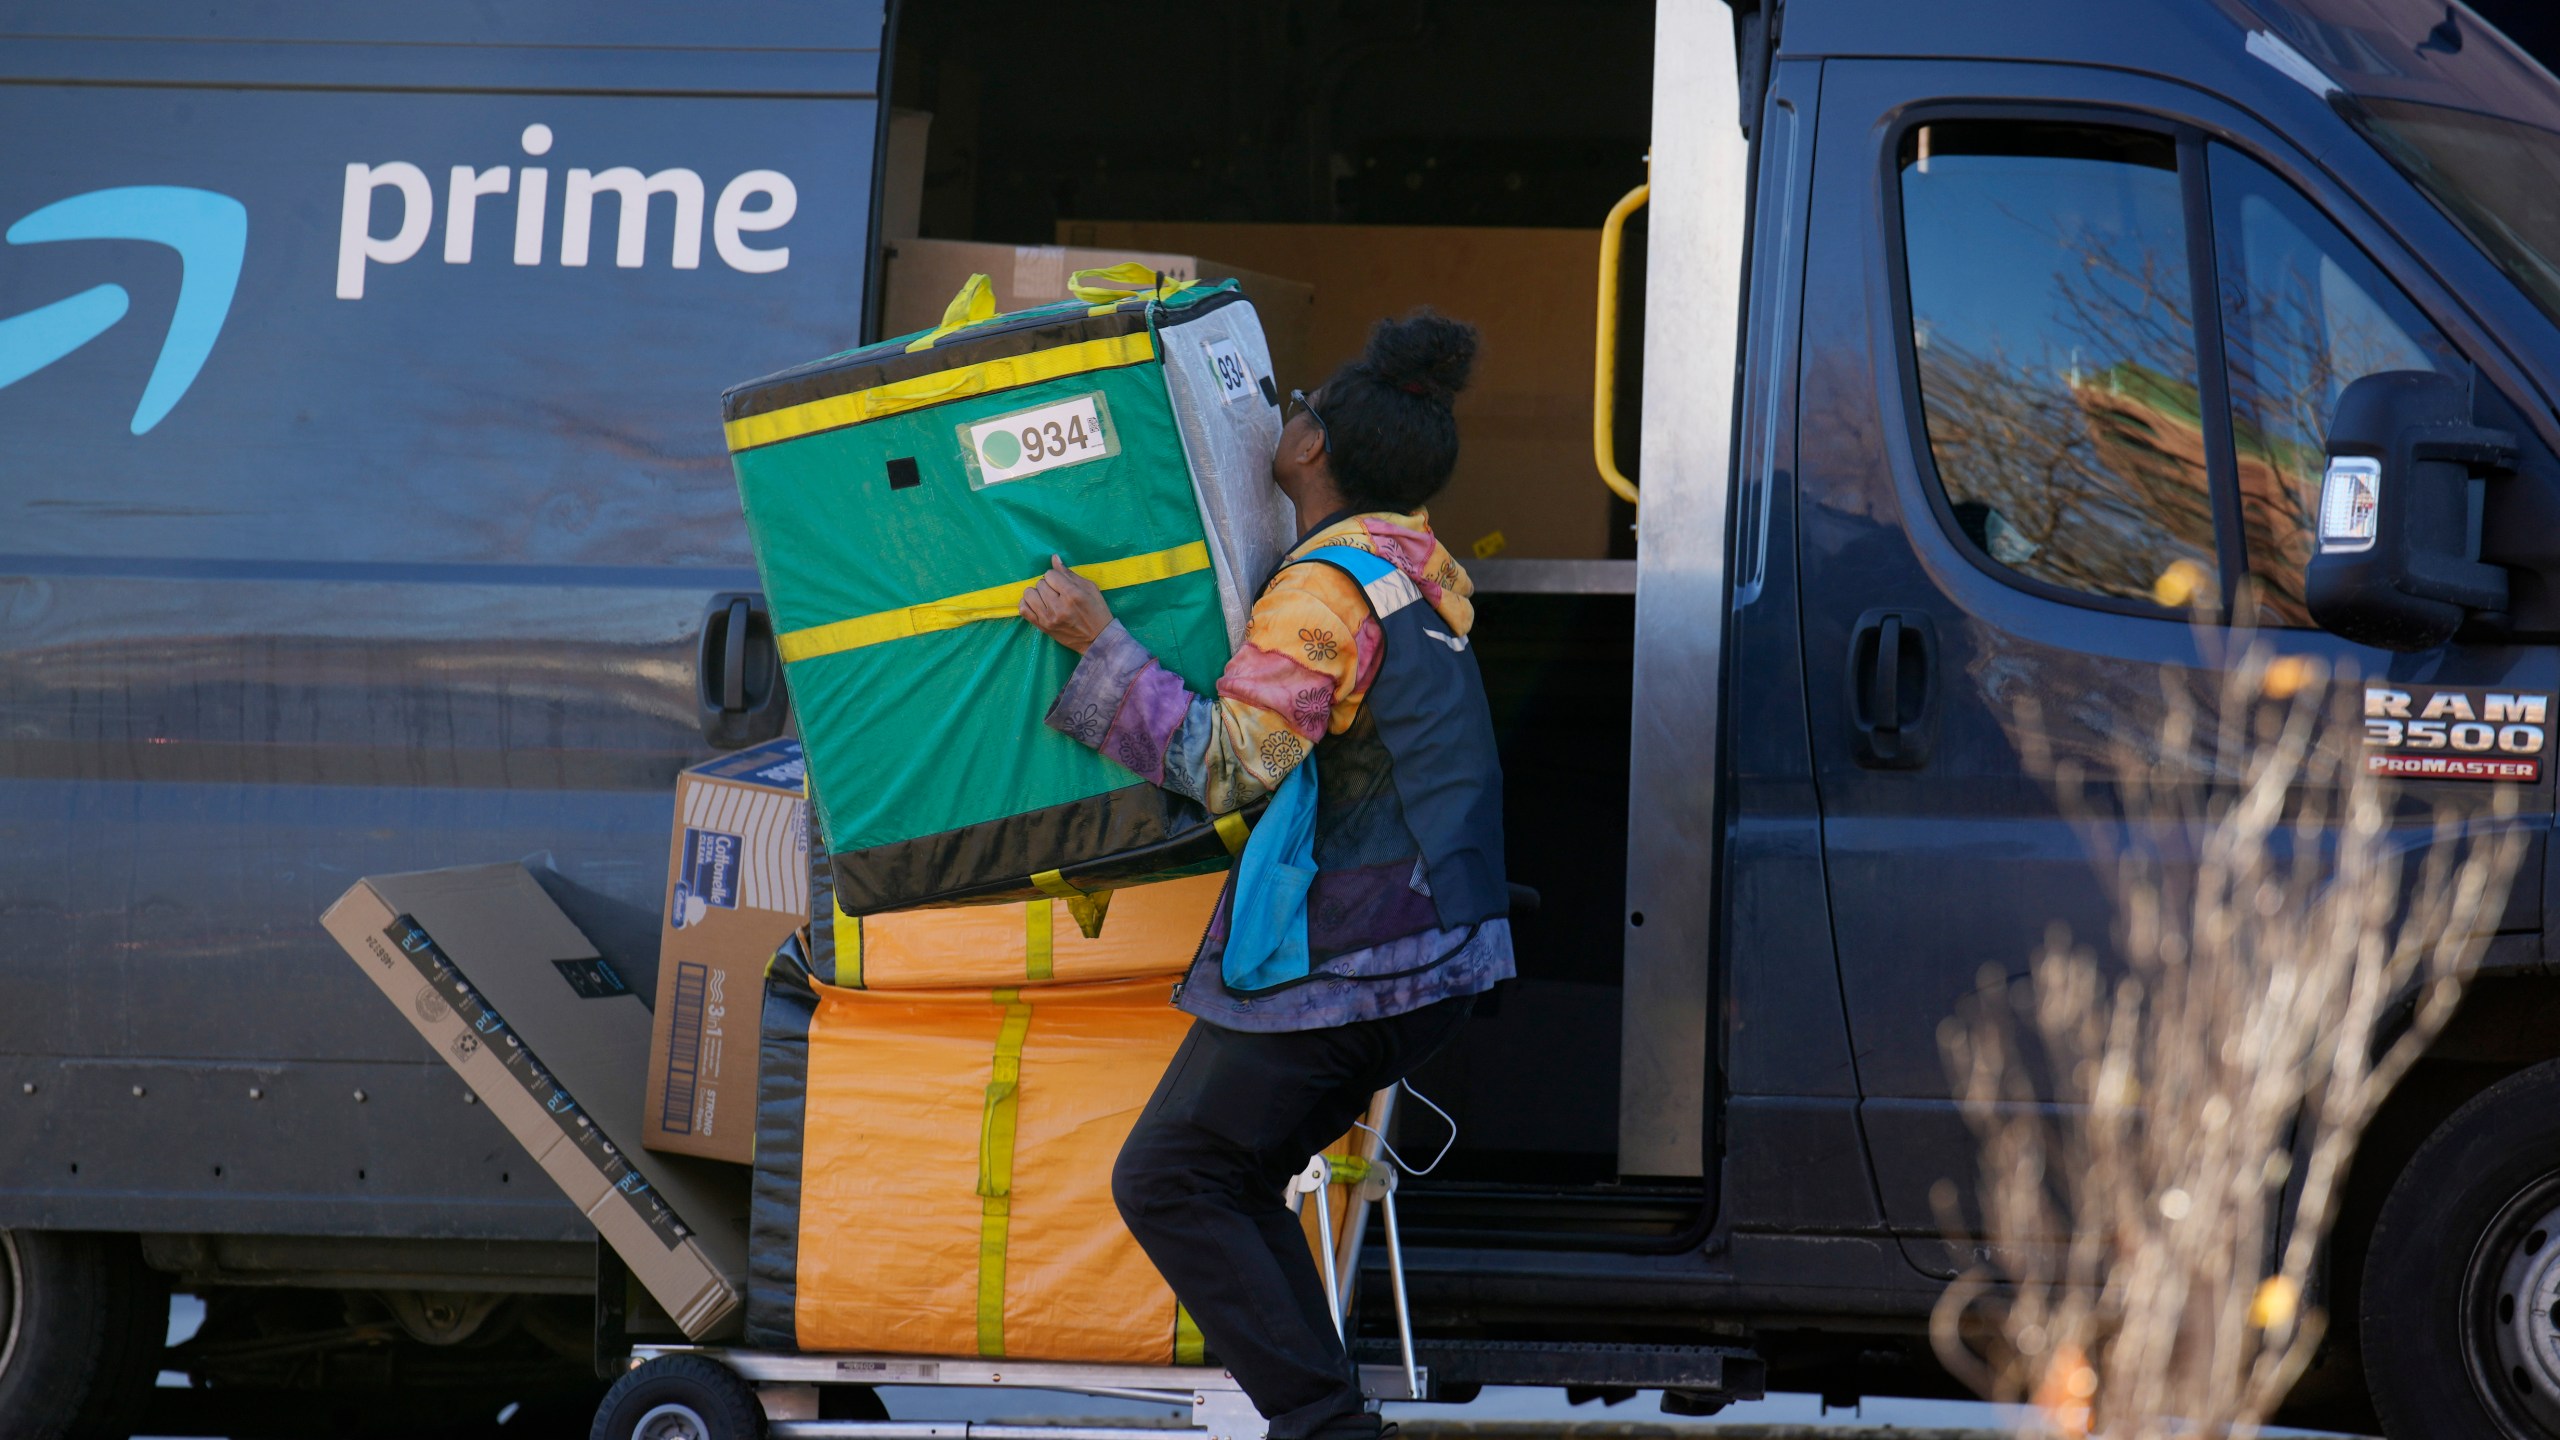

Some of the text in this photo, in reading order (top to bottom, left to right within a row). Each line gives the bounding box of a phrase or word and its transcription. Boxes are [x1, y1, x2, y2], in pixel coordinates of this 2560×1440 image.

[336, 123, 798, 300] prime
[1021, 415, 1088, 462] 934
[2364, 688, 2548, 724] RAM
[2363, 718, 2544, 754] 3500
[698, 834, 707, 865] CLEAN
[705, 835, 714, 863] ULTRA
[711, 836, 731, 904] Cottonelle
[706, 1003, 725, 1036] 3in1
[703, 1088, 716, 1136] STRONG
